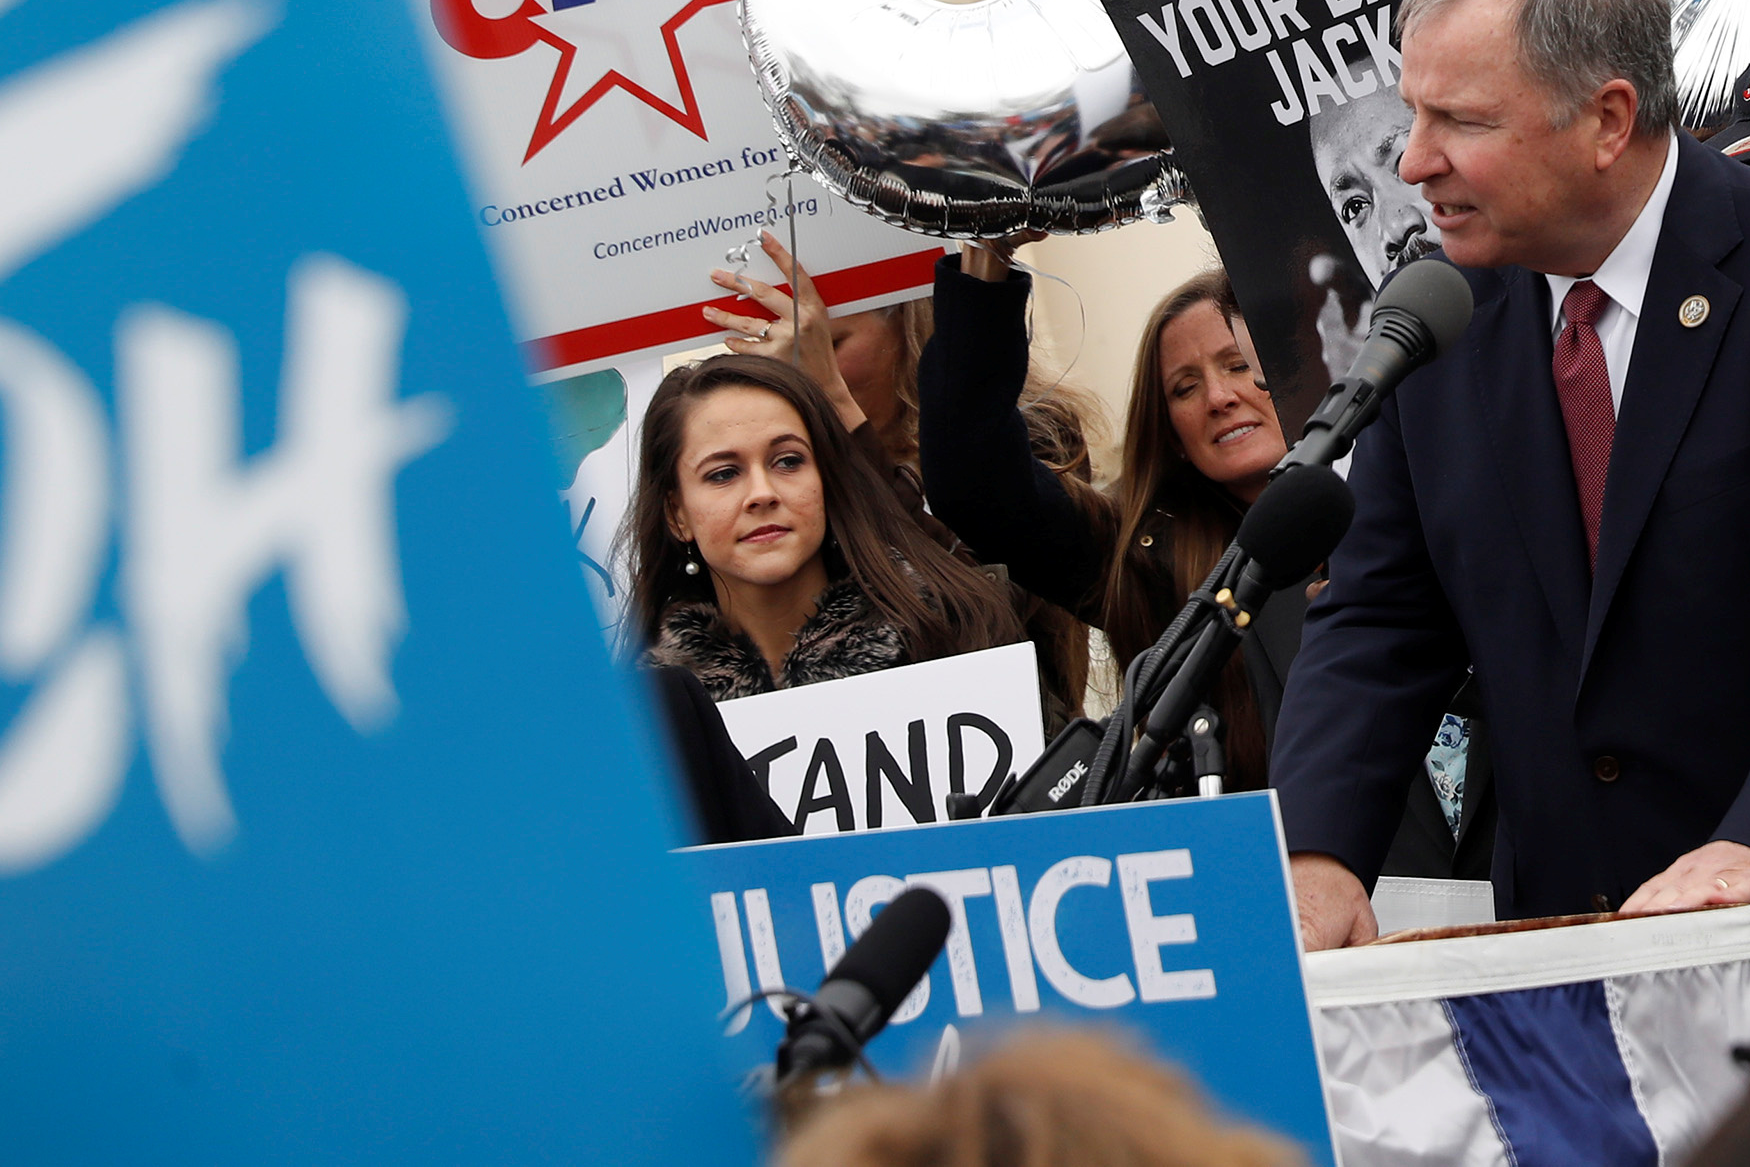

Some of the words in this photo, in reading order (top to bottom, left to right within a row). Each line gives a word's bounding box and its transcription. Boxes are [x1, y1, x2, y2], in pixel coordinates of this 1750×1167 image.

[1266, 4, 1402, 126] JACK
[479, 177, 626, 227] Concerned
[629, 152, 735, 192] Women
[740, 145, 778, 170] for
[594, 197, 818, 260] ConcernedWomen.org
[1048, 760, 1088, 802] RØDE
